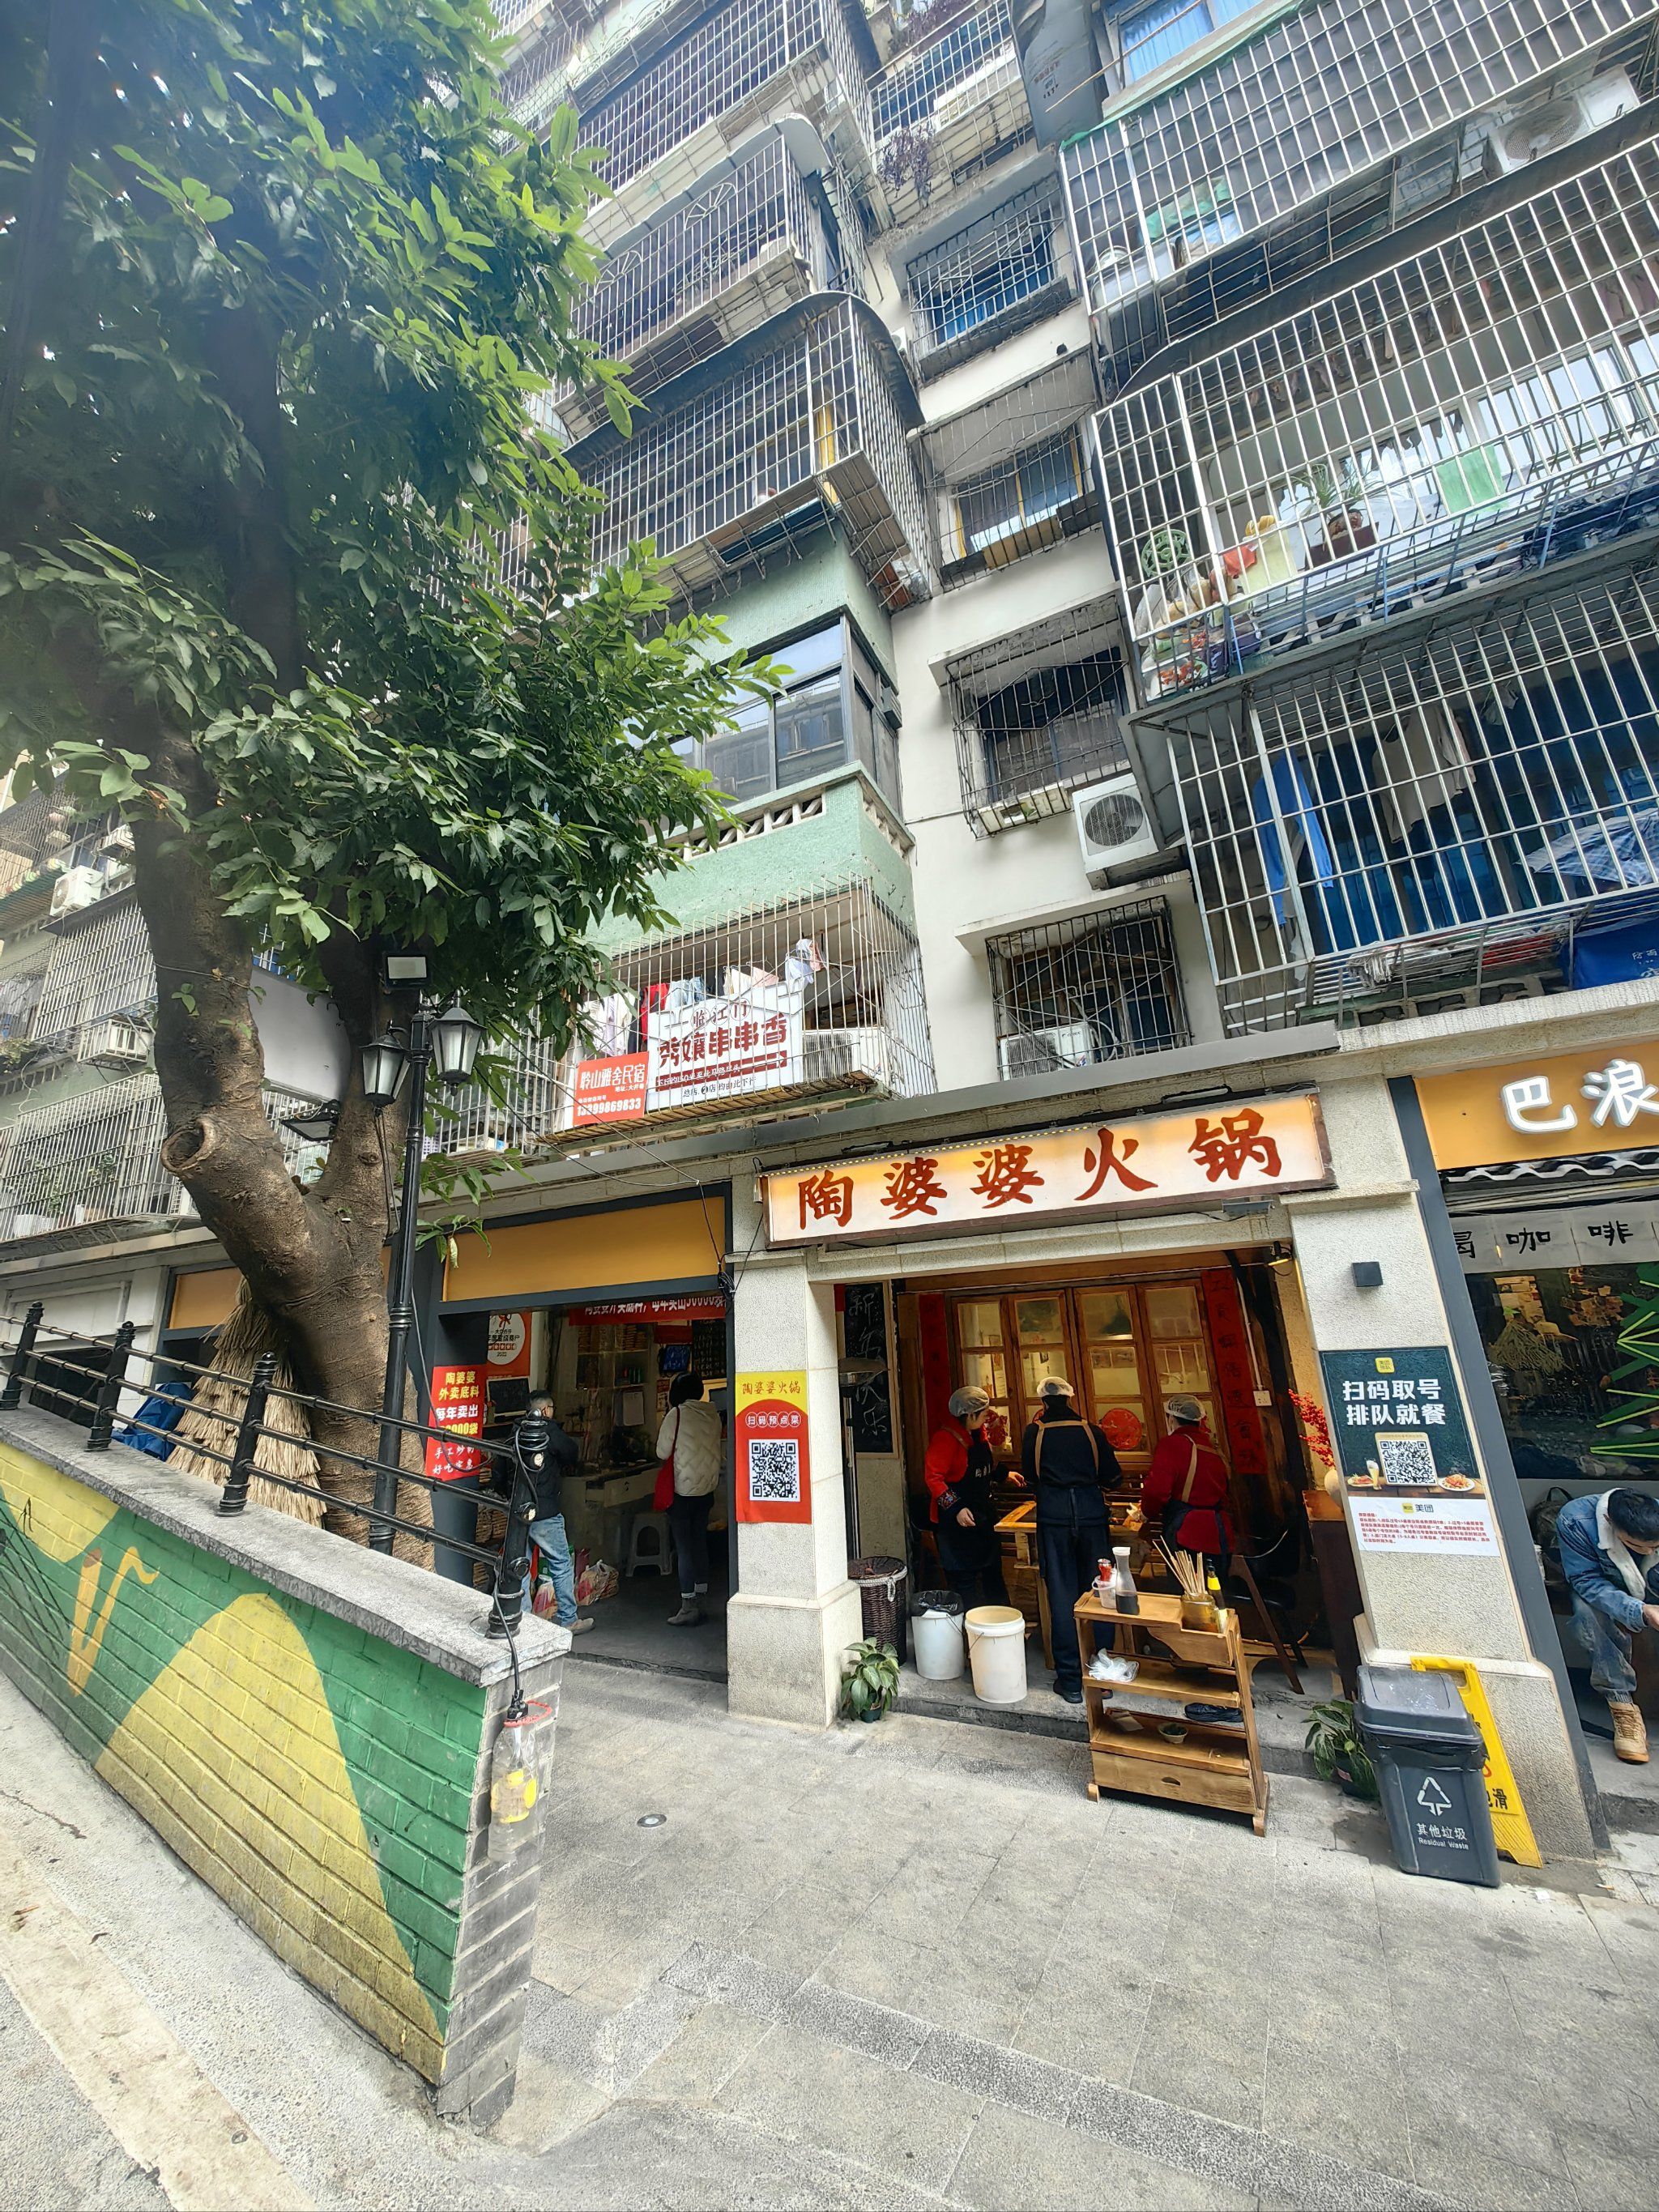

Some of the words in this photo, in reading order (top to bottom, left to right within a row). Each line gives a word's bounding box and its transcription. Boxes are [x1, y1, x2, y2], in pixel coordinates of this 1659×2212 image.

[693, 1001, 748, 1028] 临江门
[799, 1109, 1282, 1230] 陶婆婆火锅
[446, 1370, 476, 1385] 陶婆婆
[439, 1386, 480, 1401] 外卖底料
[742, 1380, 801, 1395] 陶婆婆火锅
[1342, 1379, 1442, 1402] 扫码取号
[435, 1404, 479, 1422] 每年卖出
[748, 1414, 800, 1426] 扫码预点菜
[1346, 1404, 1446, 1426] 排队就餐
[1417, 1822, 1467, 1840] 其他垃圾
[1418, 1837, 1446, 1848] Residual
[1448, 1840, 1469, 1850] Waste
